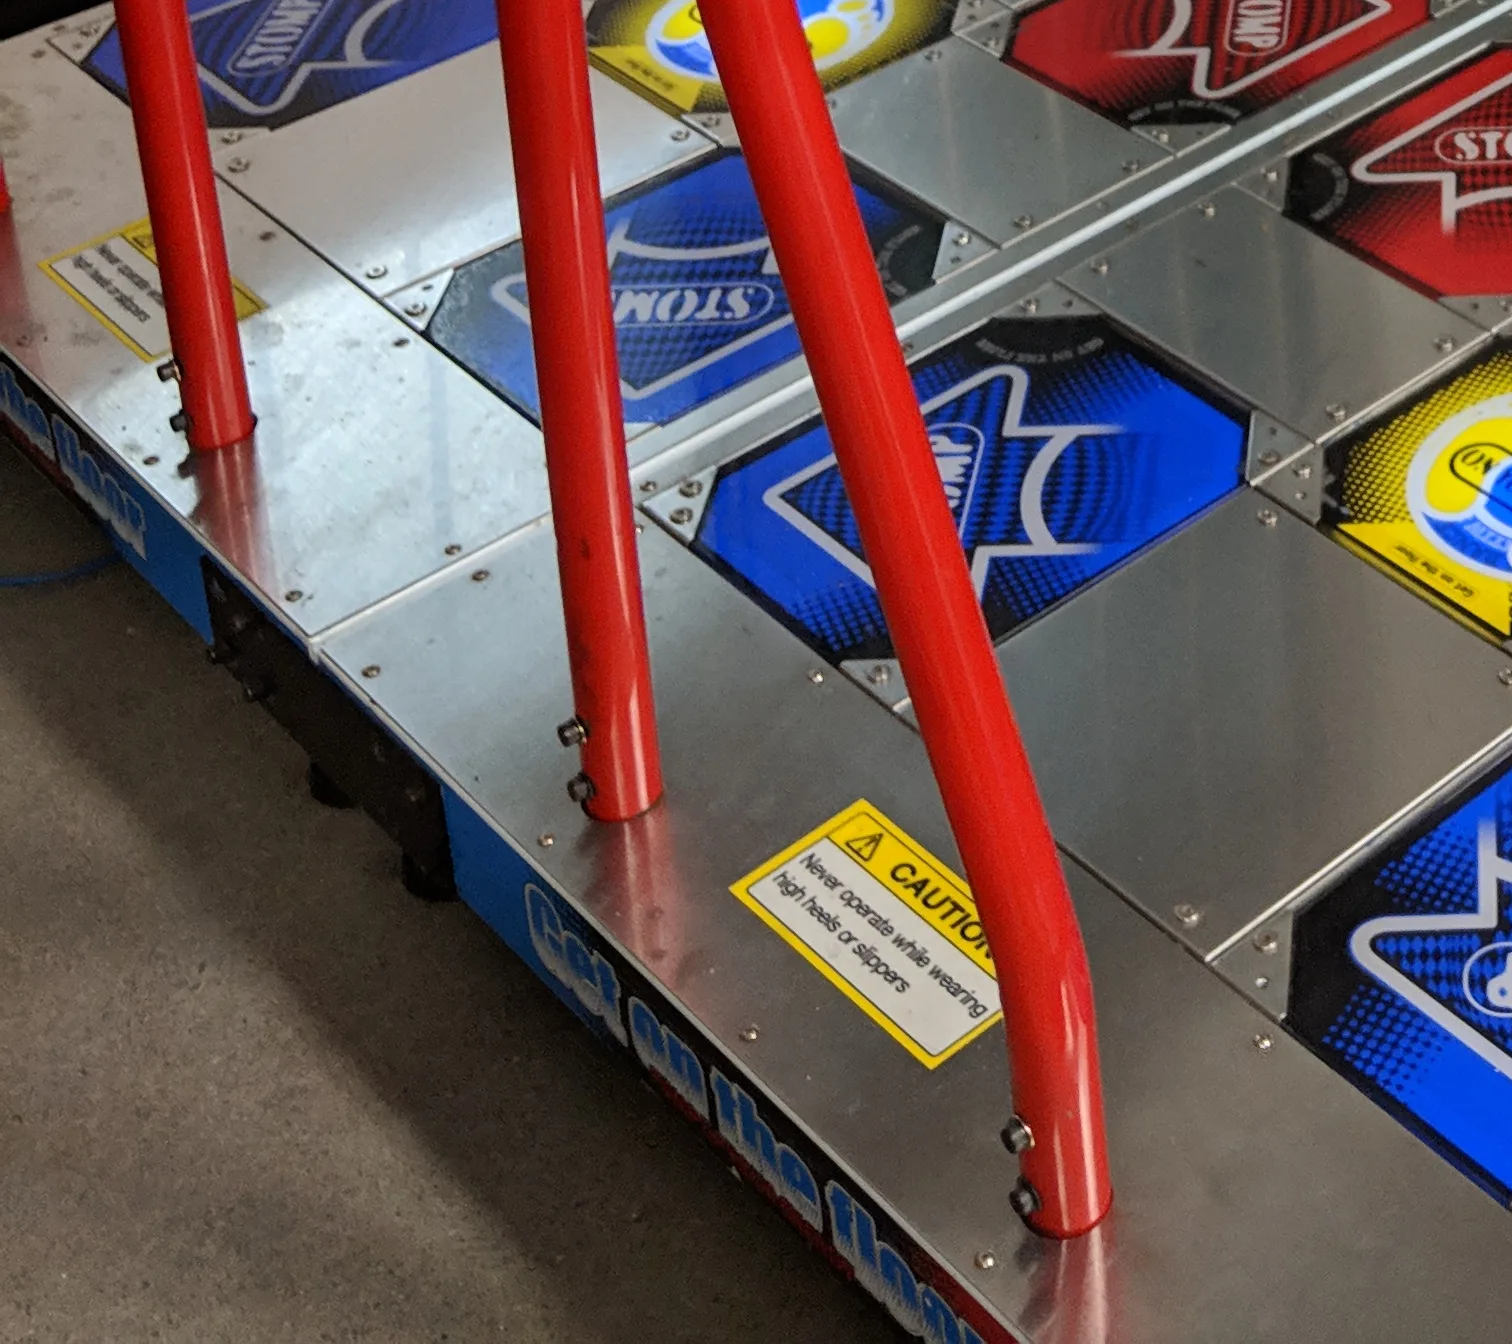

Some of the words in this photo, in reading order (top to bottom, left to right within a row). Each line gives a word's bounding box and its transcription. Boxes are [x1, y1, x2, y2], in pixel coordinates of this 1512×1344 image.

[612, 286, 756, 322] STOM
[773, 870, 806, 903] high
[802, 896, 841, 934] heels
[837, 930, 858, 944] or
[852, 941, 912, 995] slippers
[799, 852, 844, 893] Never
[839, 887, 894, 937] operate
[891, 932, 931, 968] while
[928, 963, 989, 1019] wearing
[522, 882, 629, 1050] Get
[627, 994, 710, 1122] on
[709, 1064, 822, 1234] the
